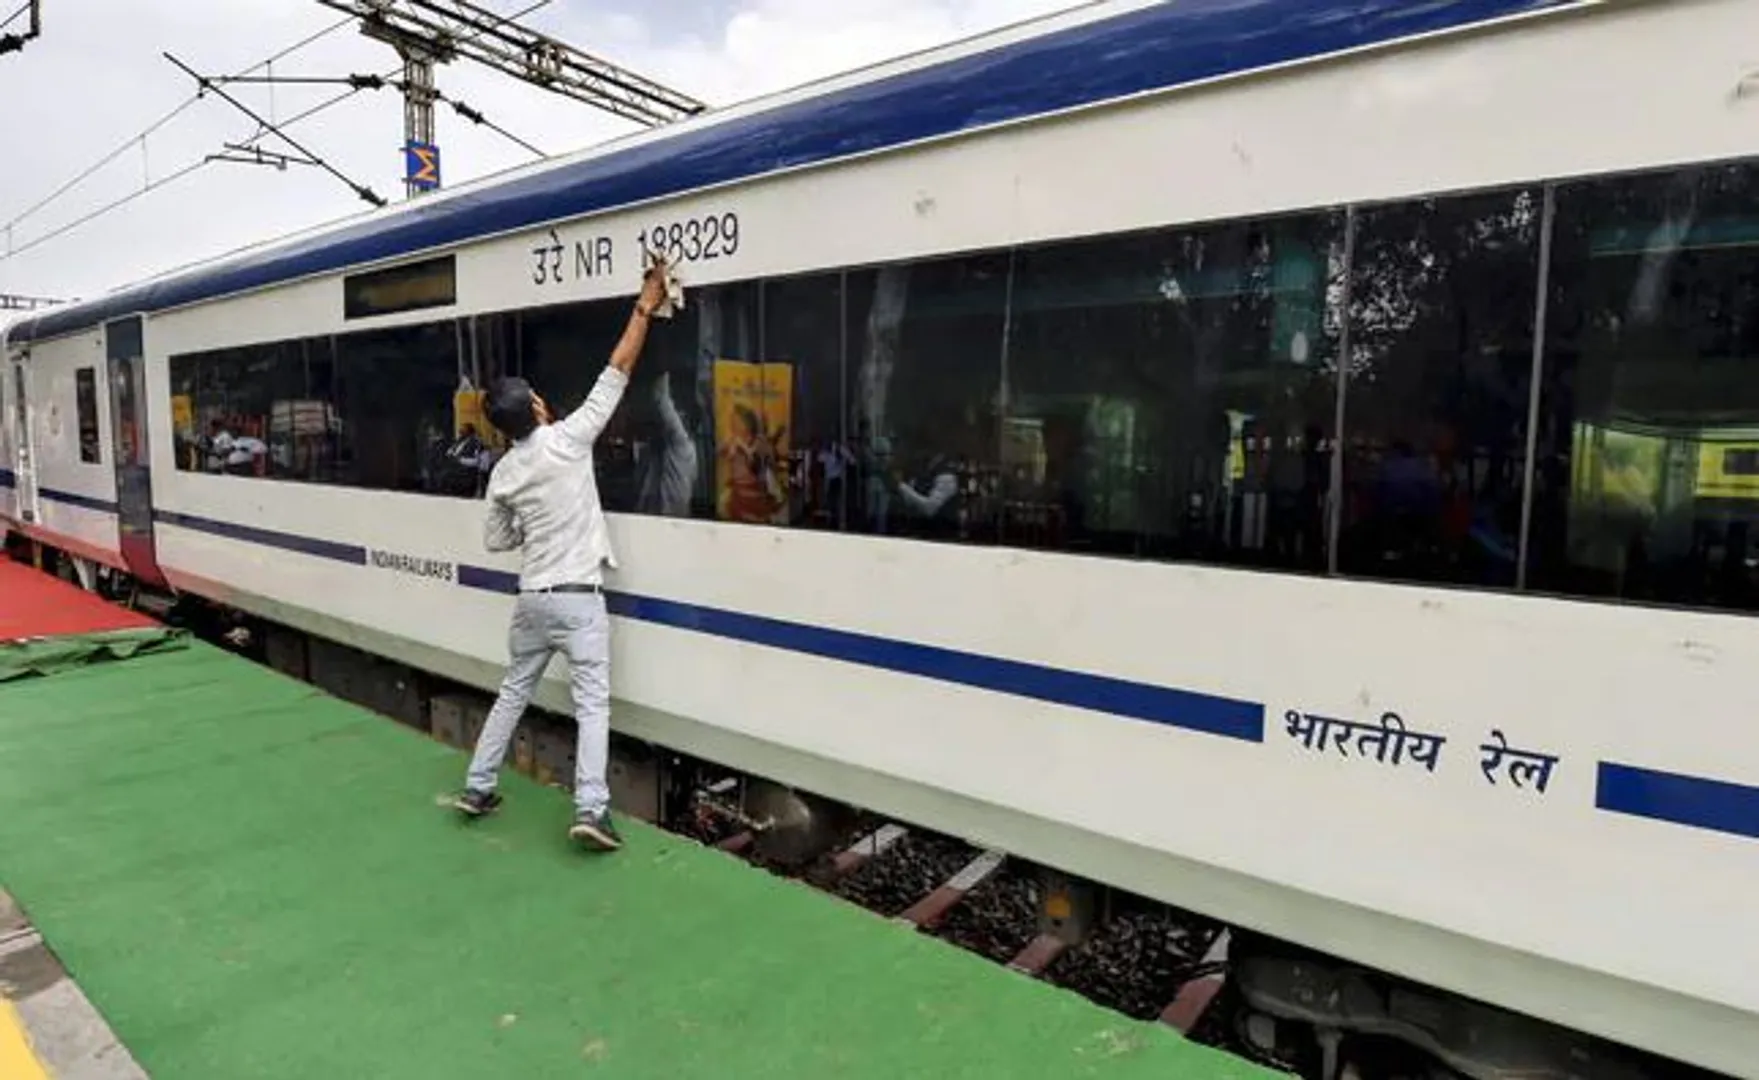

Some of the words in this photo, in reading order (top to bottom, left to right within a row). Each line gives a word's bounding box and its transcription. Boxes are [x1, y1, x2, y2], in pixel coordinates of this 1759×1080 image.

[532, 229, 564, 285] उरे
[575, 236, 613, 280] NR
[1284, 708, 1446, 773] भारतीय
[1479, 729, 1559, 794] रेल
